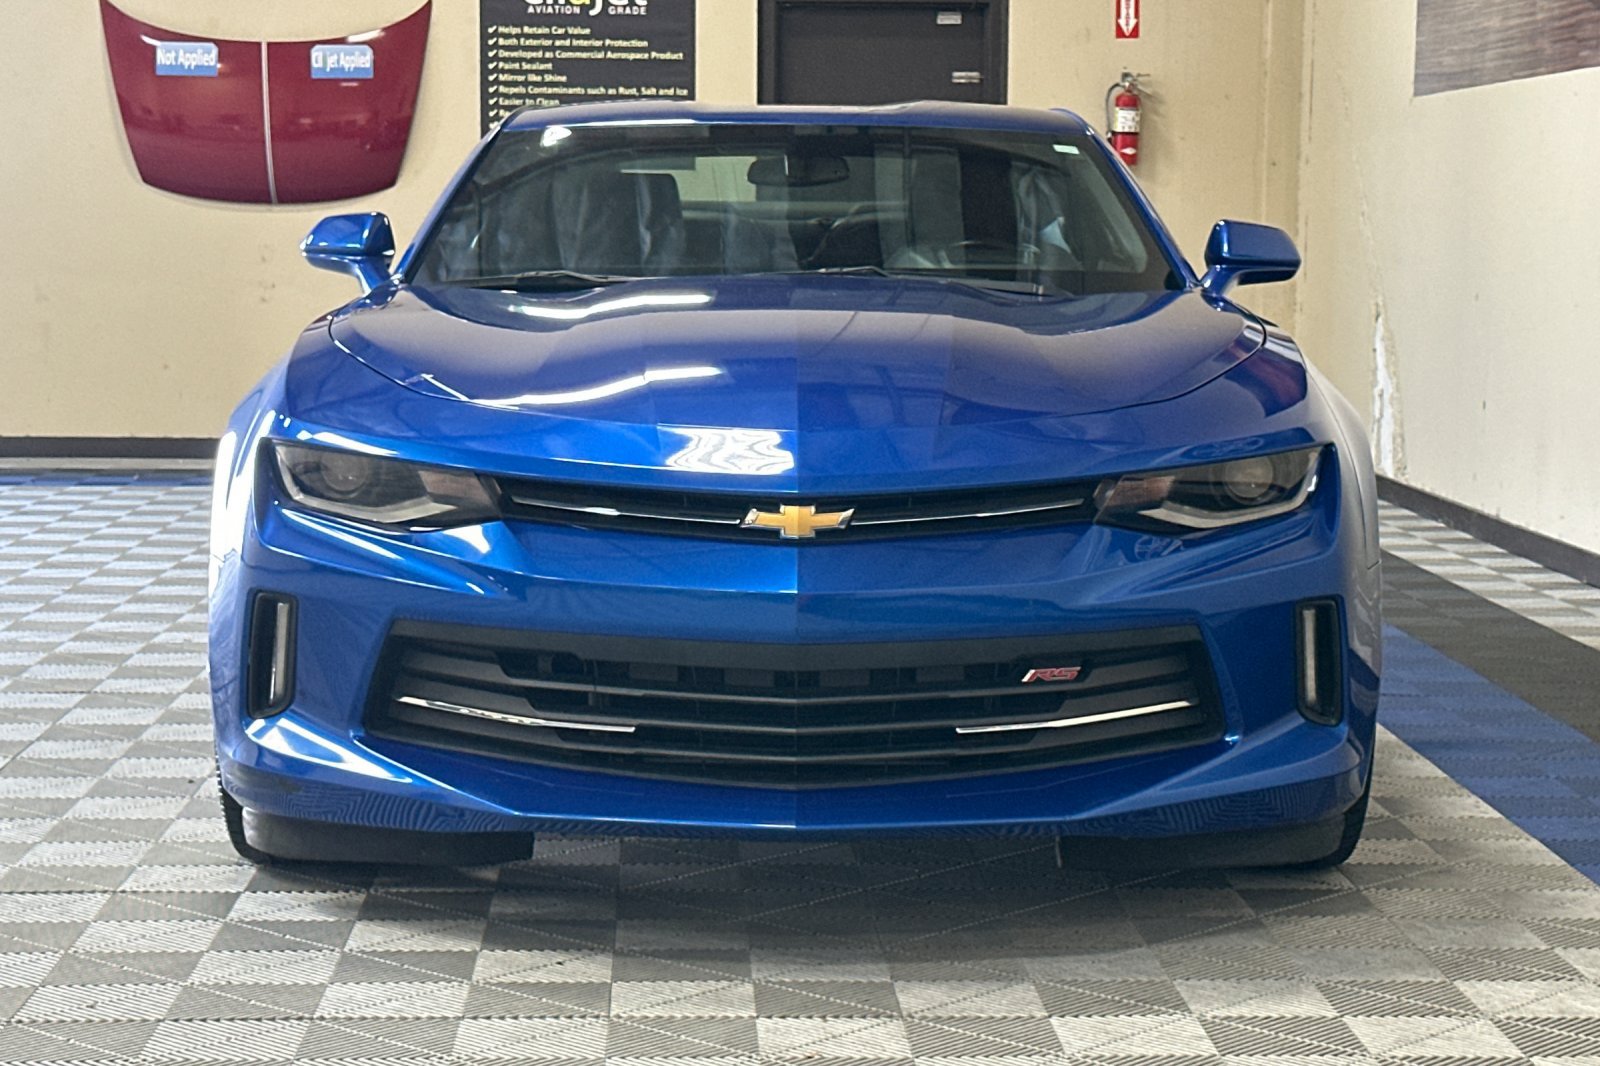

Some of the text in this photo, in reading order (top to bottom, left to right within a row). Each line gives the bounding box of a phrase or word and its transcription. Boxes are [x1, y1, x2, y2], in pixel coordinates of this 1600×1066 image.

[527, 5, 581, 15] AVIATION
[608, 6, 648, 15] GRADE
[498, 26, 591, 35] Helps Retain Car Value
[498, 37, 649, 47] Both Exterior and Interior Protection
[157, 49, 216, 69] Not Applied
[498, 49, 543, 59] Developed
[555, 50, 605, 59] Commercial
[606, 51, 650, 61] Aerospace
[651, 51, 684, 60] Product
[338, 51, 371, 72] Applied
[498, 61, 553, 70] Paint Sealant
[498, 73, 567, 82] Mirror like Shine
[499, 85, 526, 95] Repels
[527, 86, 585, 95] Contaminants
[587, 86, 606, 95] such
[618, 87, 639, 96] Rust,
[640, 86, 657, 95] Salt
[658, 87, 674, 96] and
[676, 87, 689, 96] Ice
[499, 97, 524, 106] Easier
[525, 98, 535, 106] to
[1023, 666, 1081, 682] RS
